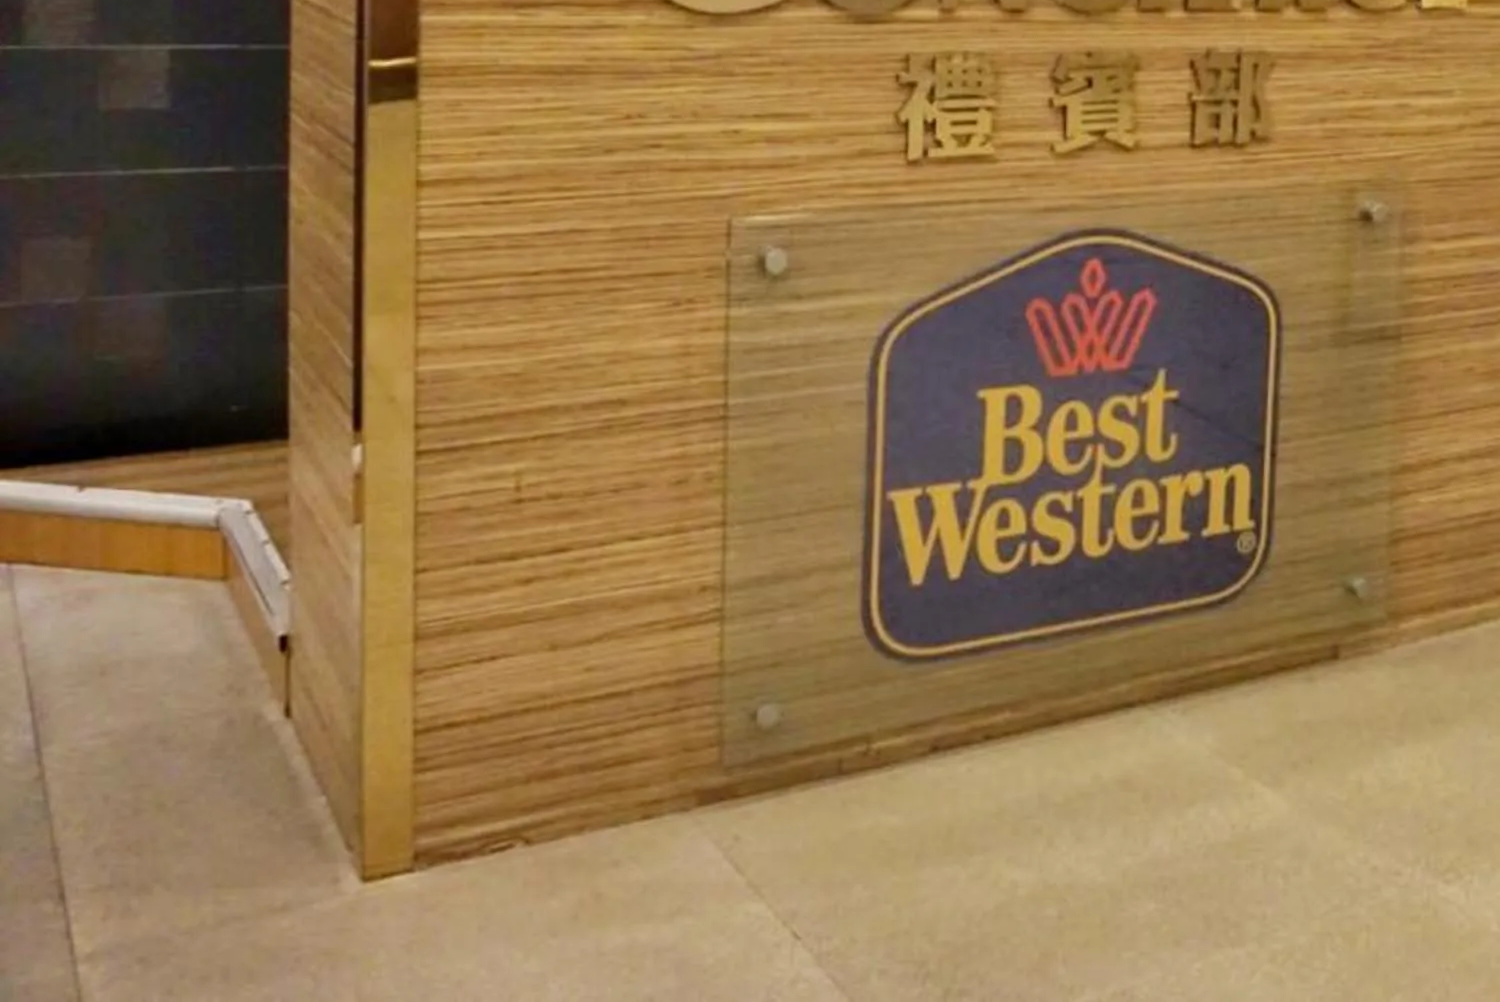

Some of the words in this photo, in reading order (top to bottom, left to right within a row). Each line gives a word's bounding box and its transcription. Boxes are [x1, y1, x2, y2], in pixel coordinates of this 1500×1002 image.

[895, 48, 1275, 163] 禮賓部
[977, 368, 1179, 487] Best
[887, 443, 1255, 586] Western
